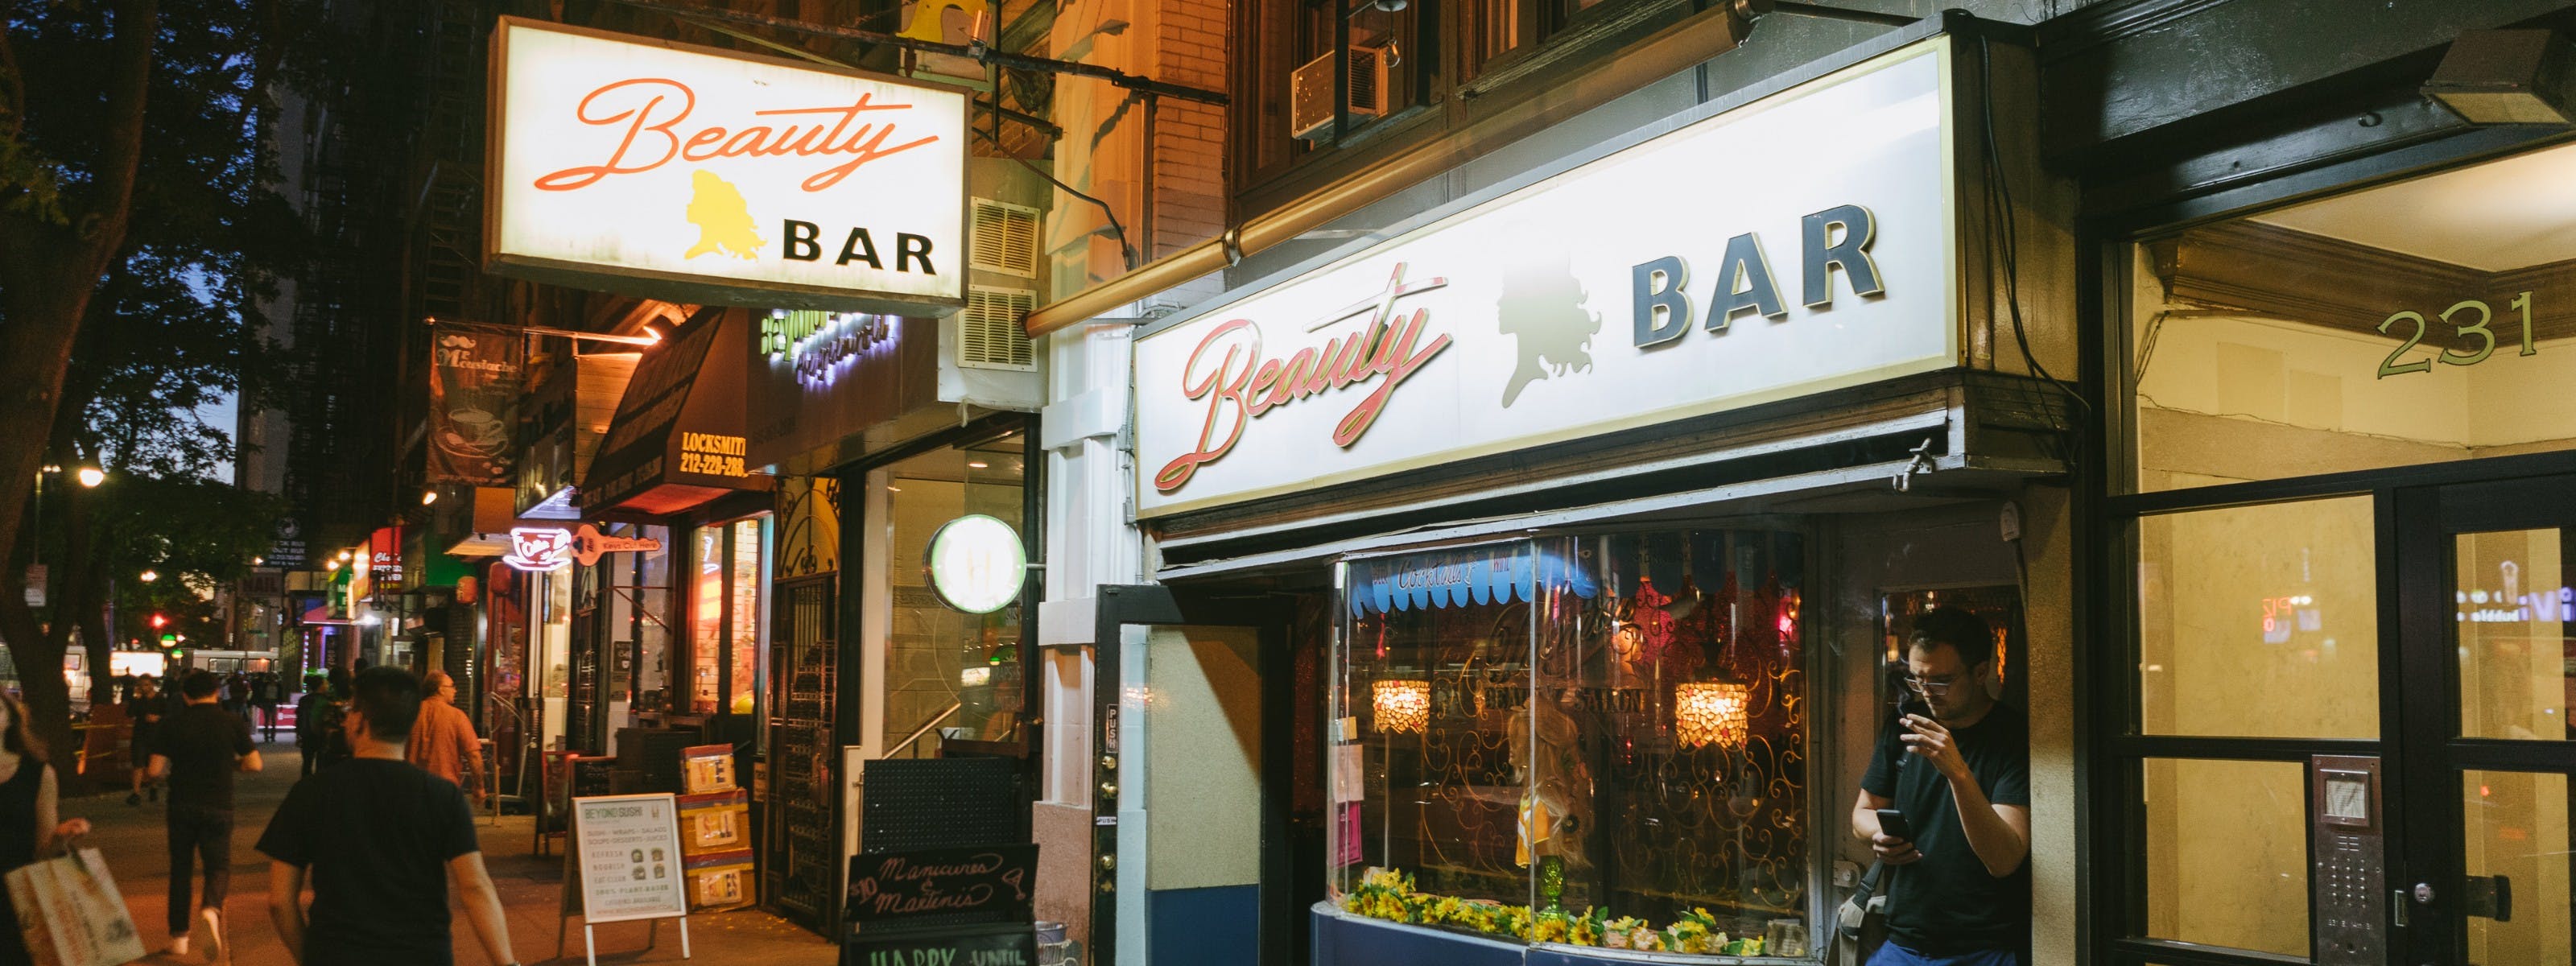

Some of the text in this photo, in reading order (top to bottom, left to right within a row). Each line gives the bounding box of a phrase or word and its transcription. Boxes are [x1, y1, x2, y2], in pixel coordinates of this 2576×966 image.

[535, 78, 939, 192] Beauty
[783, 218, 936, 276] BAR
[1630, 203, 1886, 349] BAR
[2376, 291, 2538, 379] 231
[1154, 262, 1452, 493] Beauty
[680, 452, 749, 477] 212-228-288
[1108, 709, 1117, 749] PUSH
[879, 853, 1003, 882] Manicures
[874, 884, 993, 914] Martinis
[972, 949, 1026, 966] UNTIL
